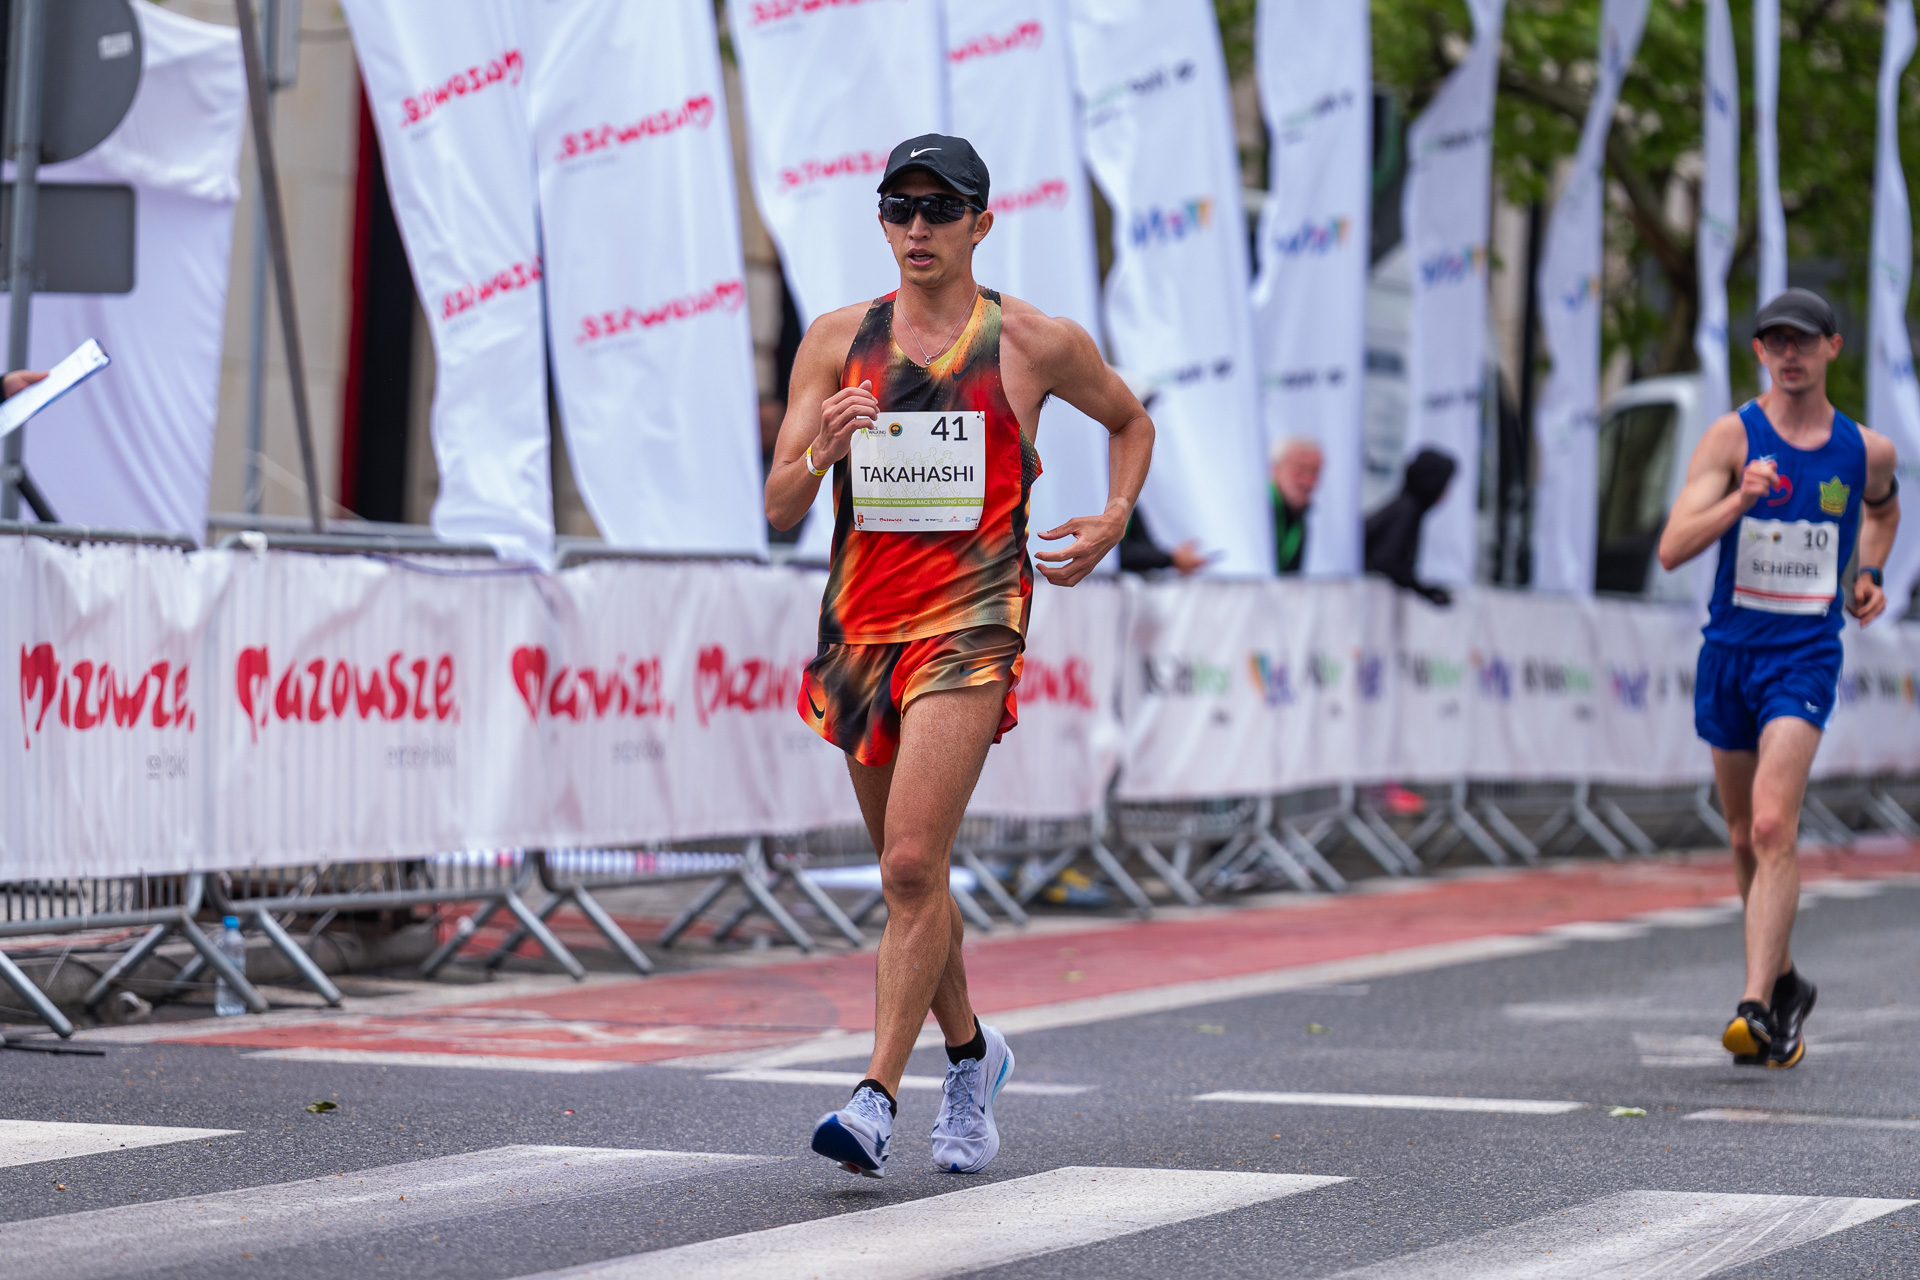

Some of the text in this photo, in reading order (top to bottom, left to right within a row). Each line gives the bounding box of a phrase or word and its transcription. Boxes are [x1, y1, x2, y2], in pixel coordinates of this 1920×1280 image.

[930, 416, 968, 441] 41
[860, 466, 974, 483] TAKAHASHI
[1804, 528, 1829, 551] 10
[1752, 559, 1821, 578] SCHIEDEL
